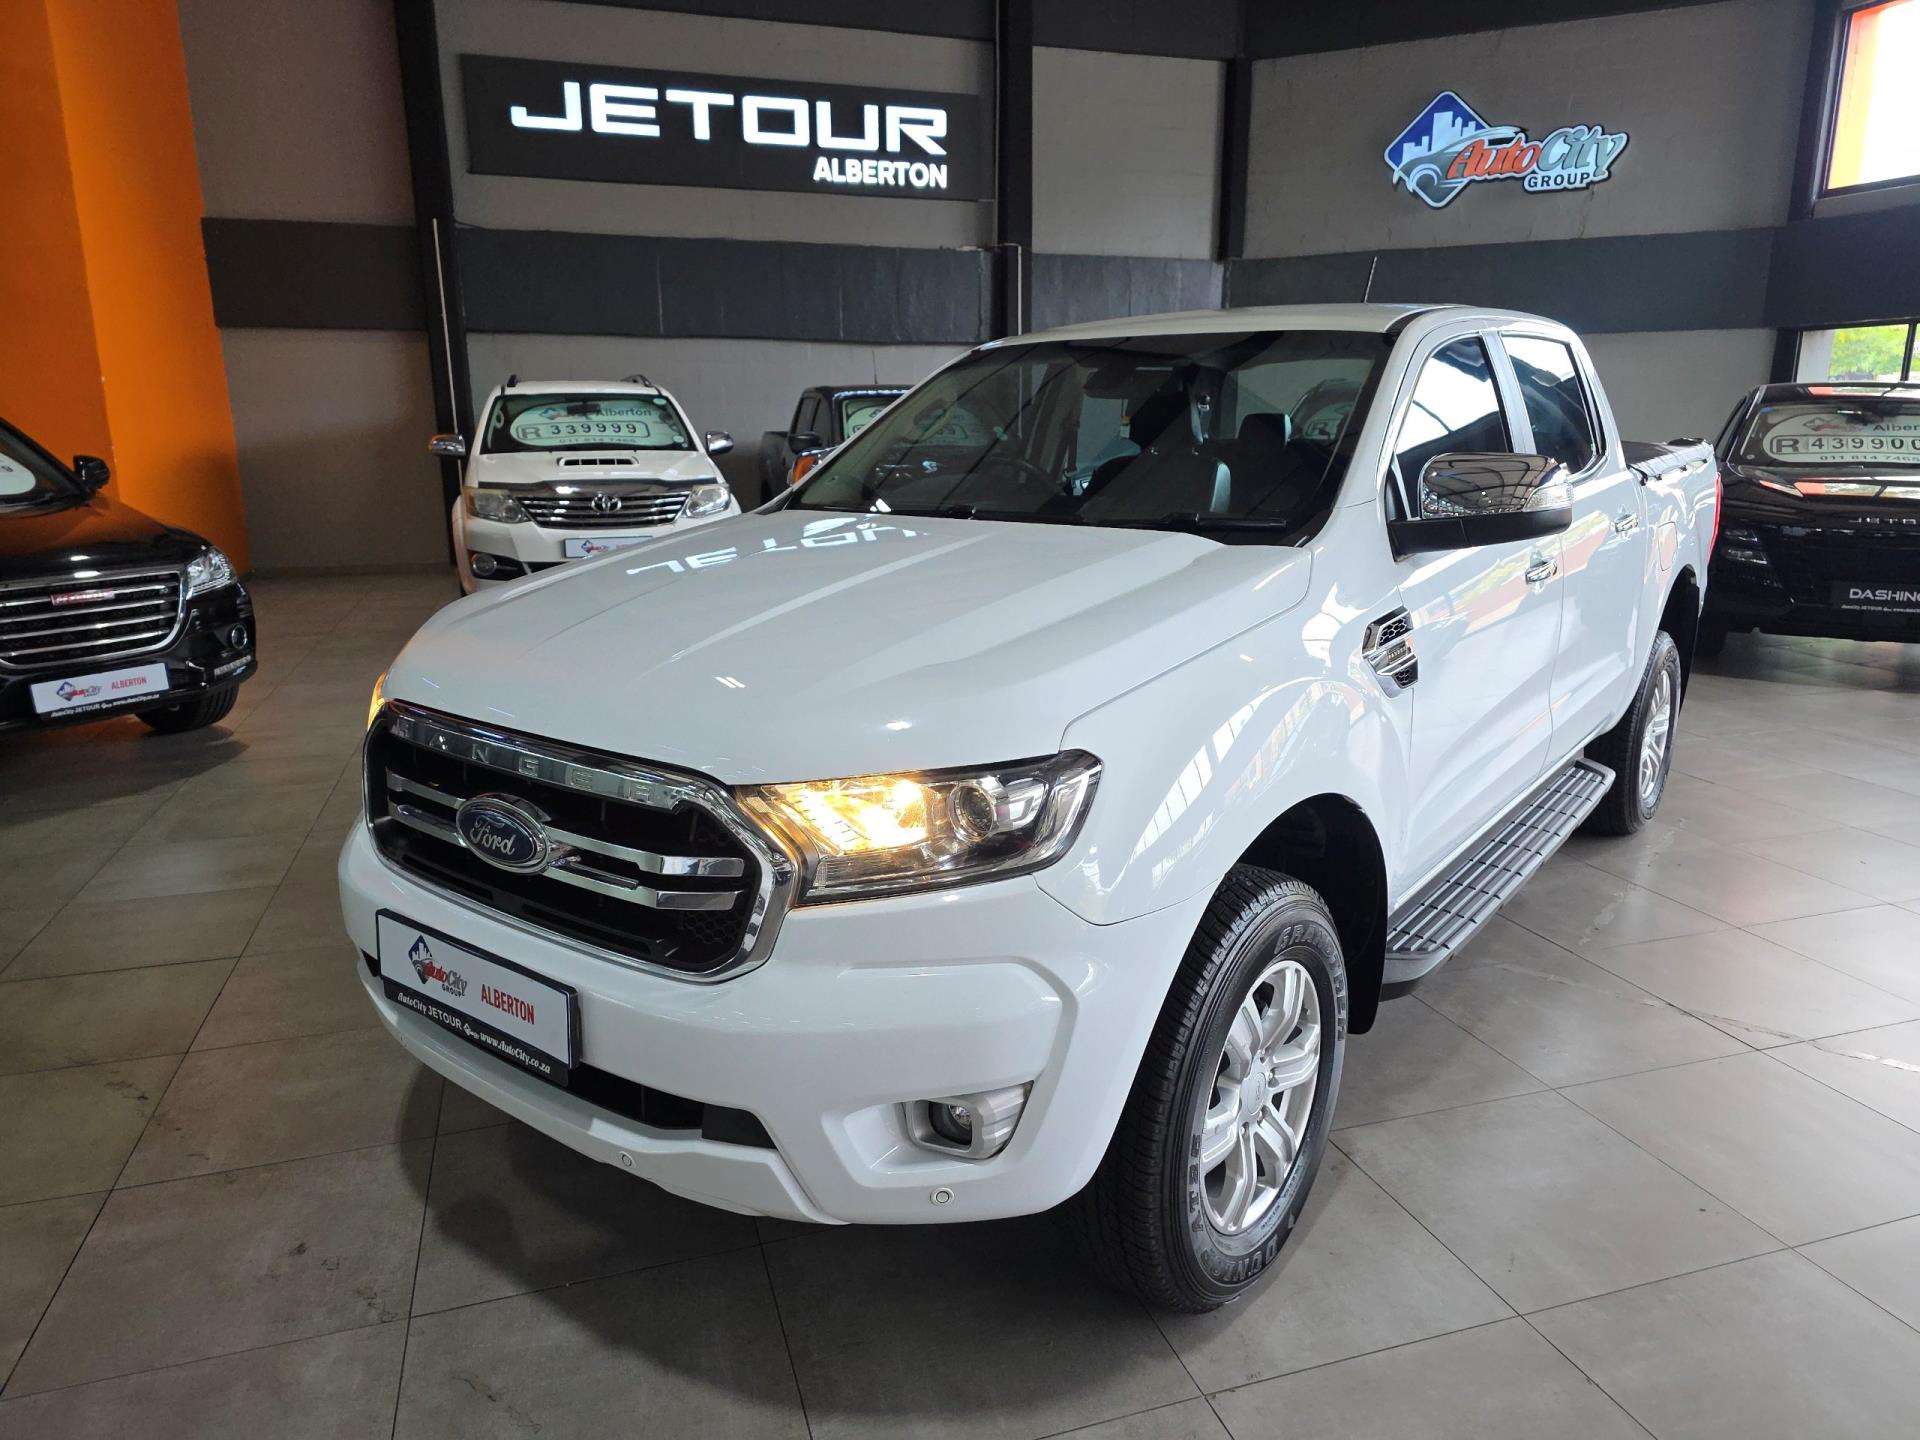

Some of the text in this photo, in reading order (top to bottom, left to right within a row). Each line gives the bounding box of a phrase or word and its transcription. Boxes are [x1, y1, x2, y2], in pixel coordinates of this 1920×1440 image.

[510, 81, 948, 155] JETOUR
[812, 156, 948, 188] ALBERTON
[1527, 172, 1592, 189] GROUP
[521, 423, 637, 439] R 339999
[1776, 438, 1920, 452] R 439900
[112, 677, 147, 690] ALBERTON
[469, 816, 516, 857] Ford
[427, 1004, 463, 1031] JETOUR
[481, 983, 535, 1025] ALBERTON
